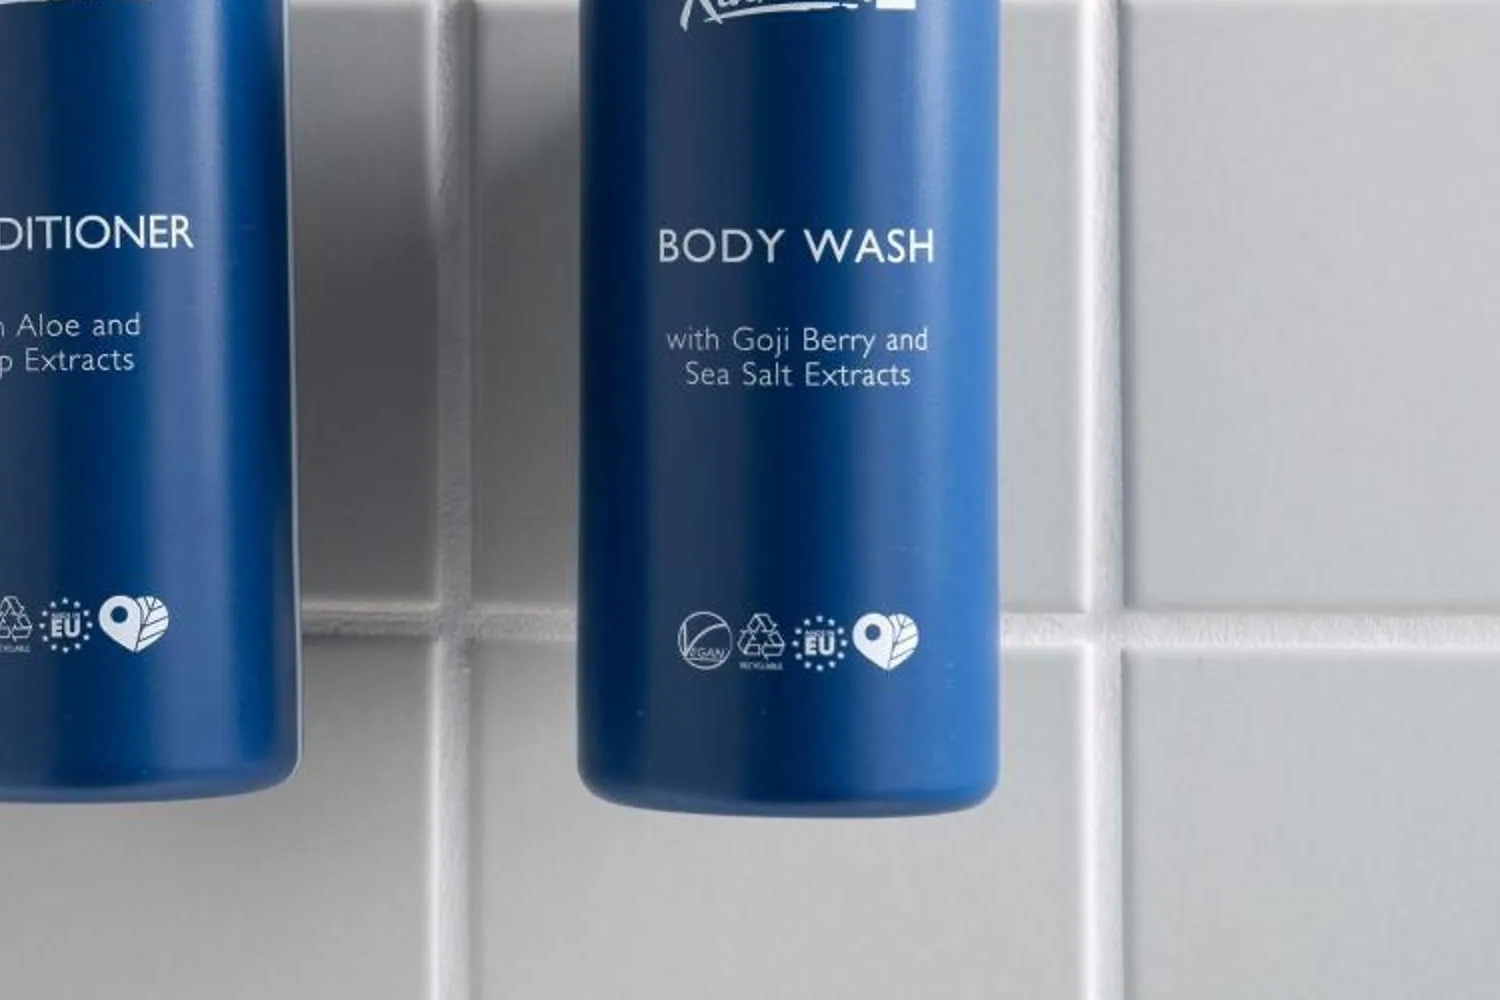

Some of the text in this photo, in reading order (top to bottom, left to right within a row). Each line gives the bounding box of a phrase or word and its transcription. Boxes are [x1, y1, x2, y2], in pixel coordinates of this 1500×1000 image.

[660, 228, 934, 263] BODY WASH
[16, 314, 80, 337] Aloe
[92, 312, 140, 336] and
[666, 326, 929, 358] with Goji Berry and
[26, 347, 134, 371] Extracts
[685, 360, 911, 387] Sea Salt Extracts
[51, 617, 80, 639] EU
[804, 634, 835, 656] EU
